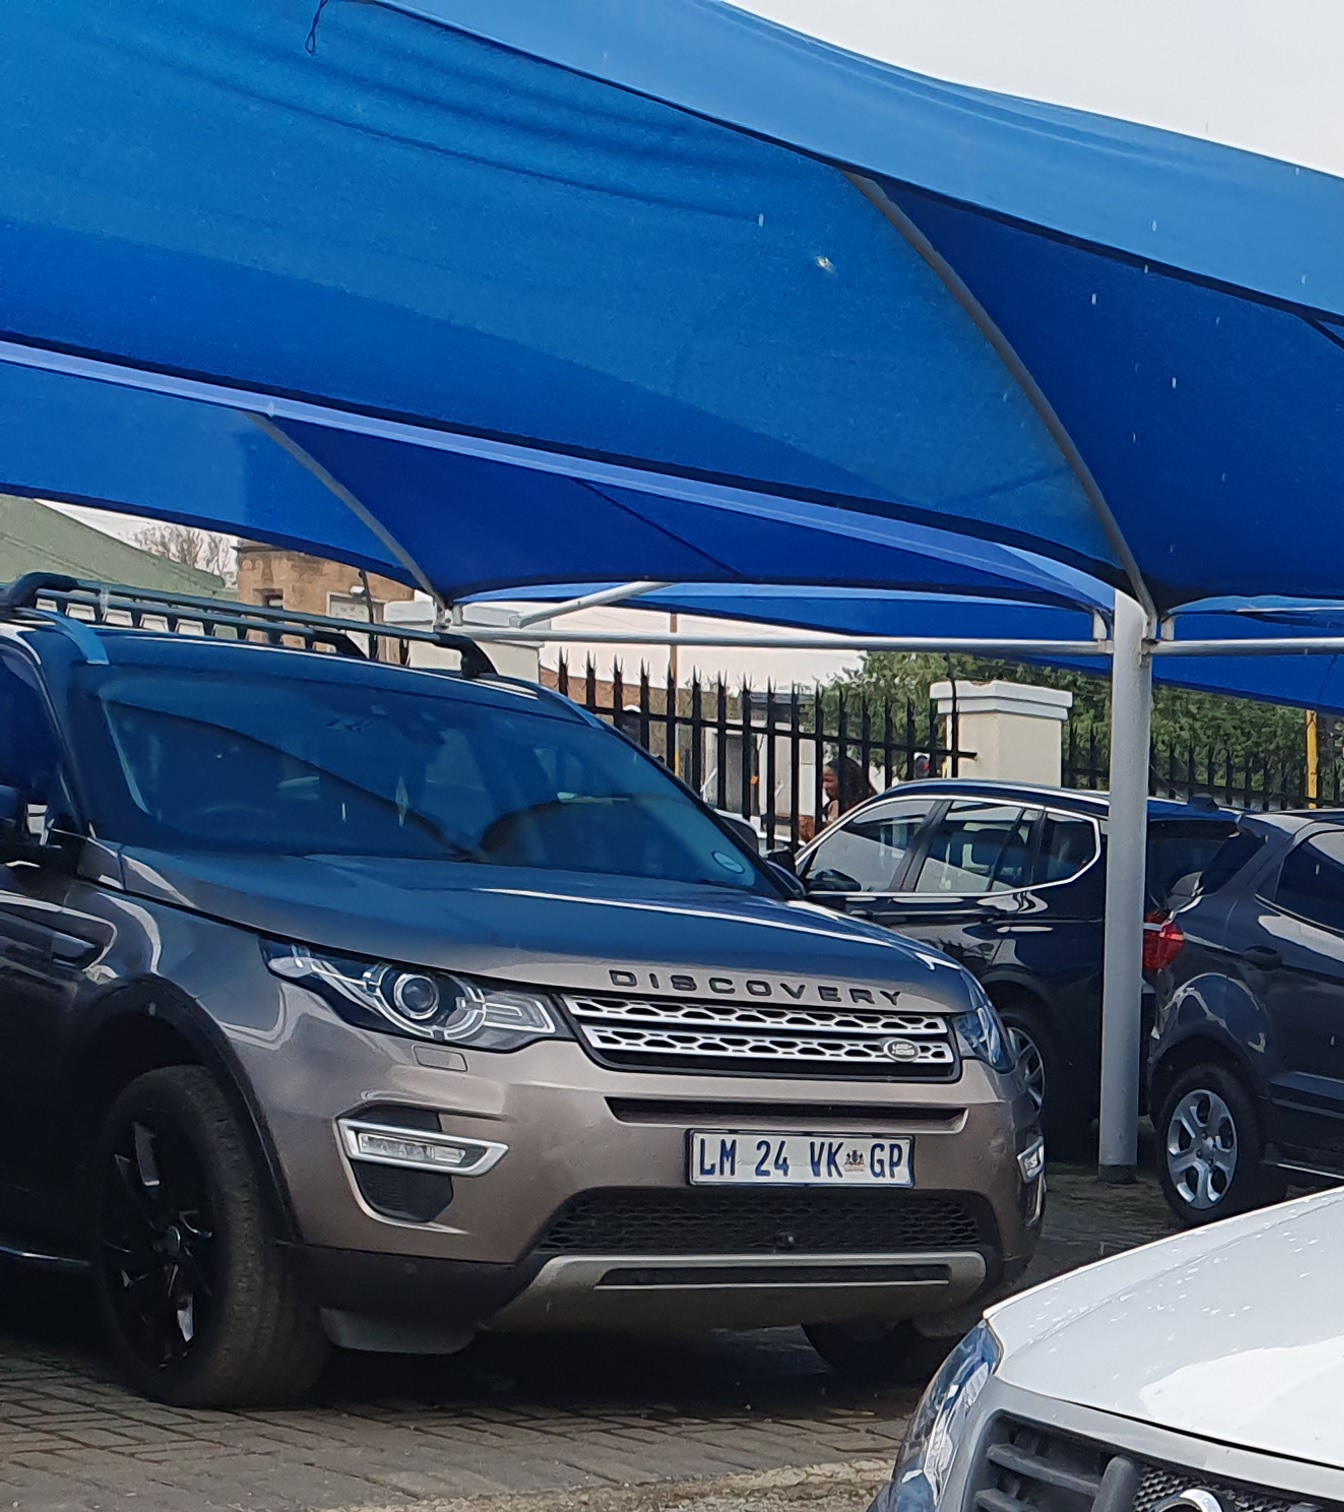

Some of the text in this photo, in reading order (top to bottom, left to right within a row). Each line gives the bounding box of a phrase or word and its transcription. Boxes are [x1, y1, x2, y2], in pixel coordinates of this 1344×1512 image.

[608, 969, 901, 1006] DISCOVERY
[699, 1138, 904, 1180] LM 24 VK GP
